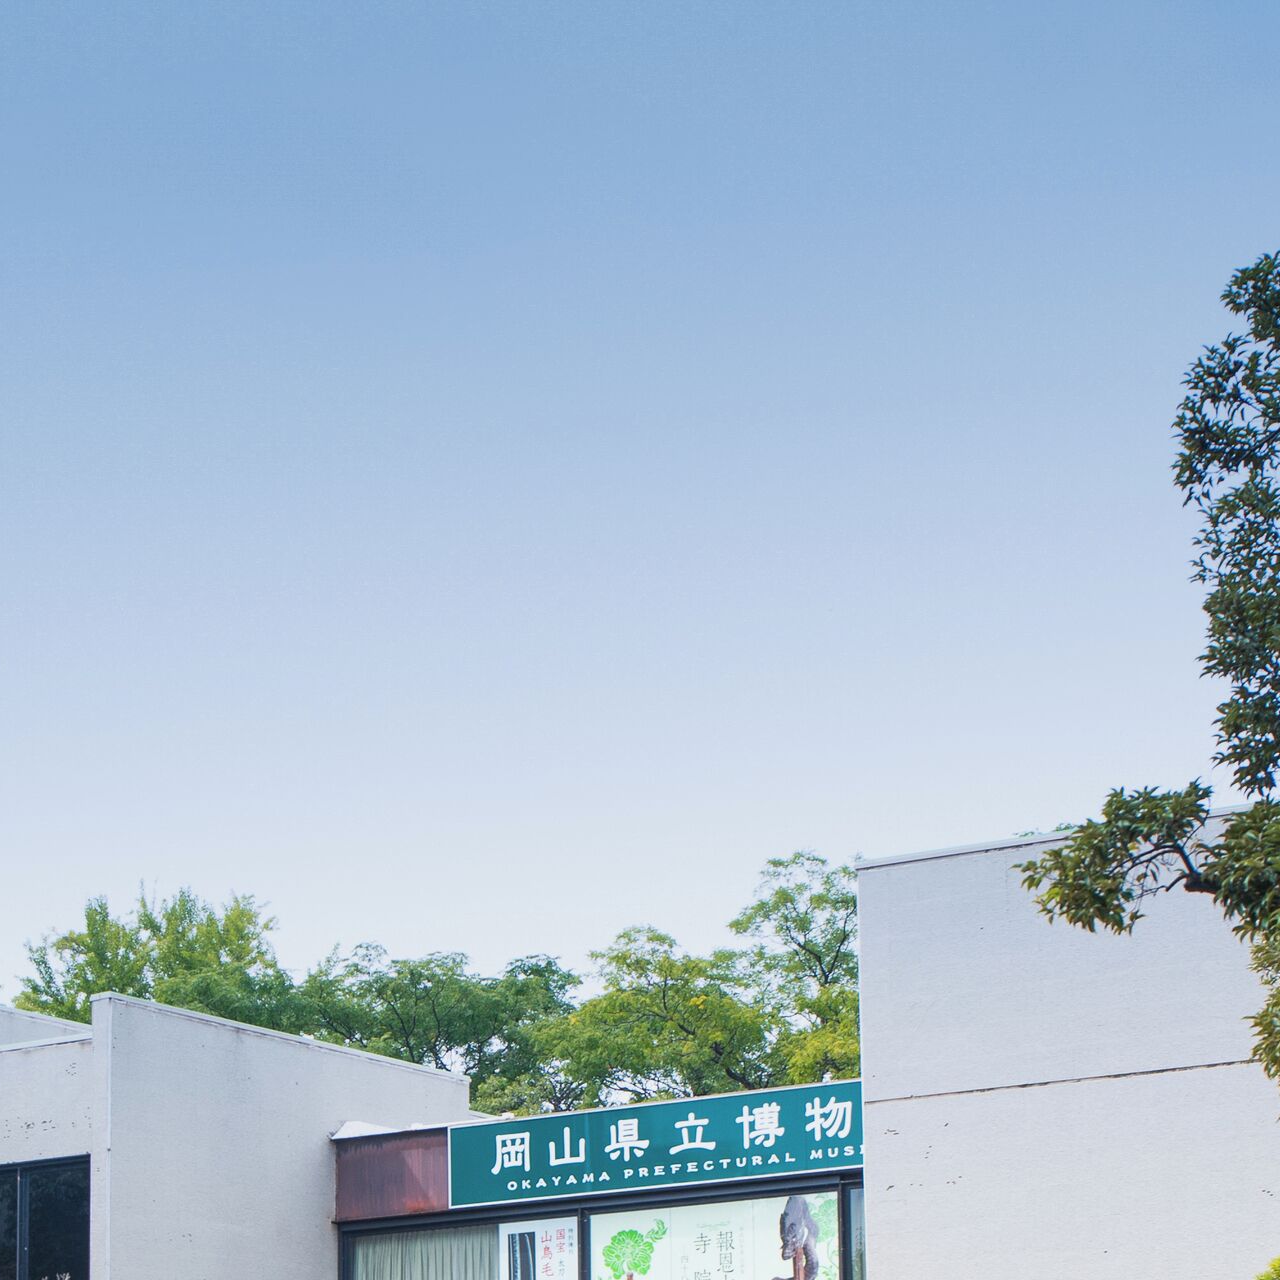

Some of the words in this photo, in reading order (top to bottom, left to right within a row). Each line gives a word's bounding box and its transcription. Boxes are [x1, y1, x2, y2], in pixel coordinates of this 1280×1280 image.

[490, 1095, 853, 1176] 岡山県立博物
[507, 1170, 611, 1191] OKAYAMA
[623, 1152, 796, 1180] PREFECTURAL
